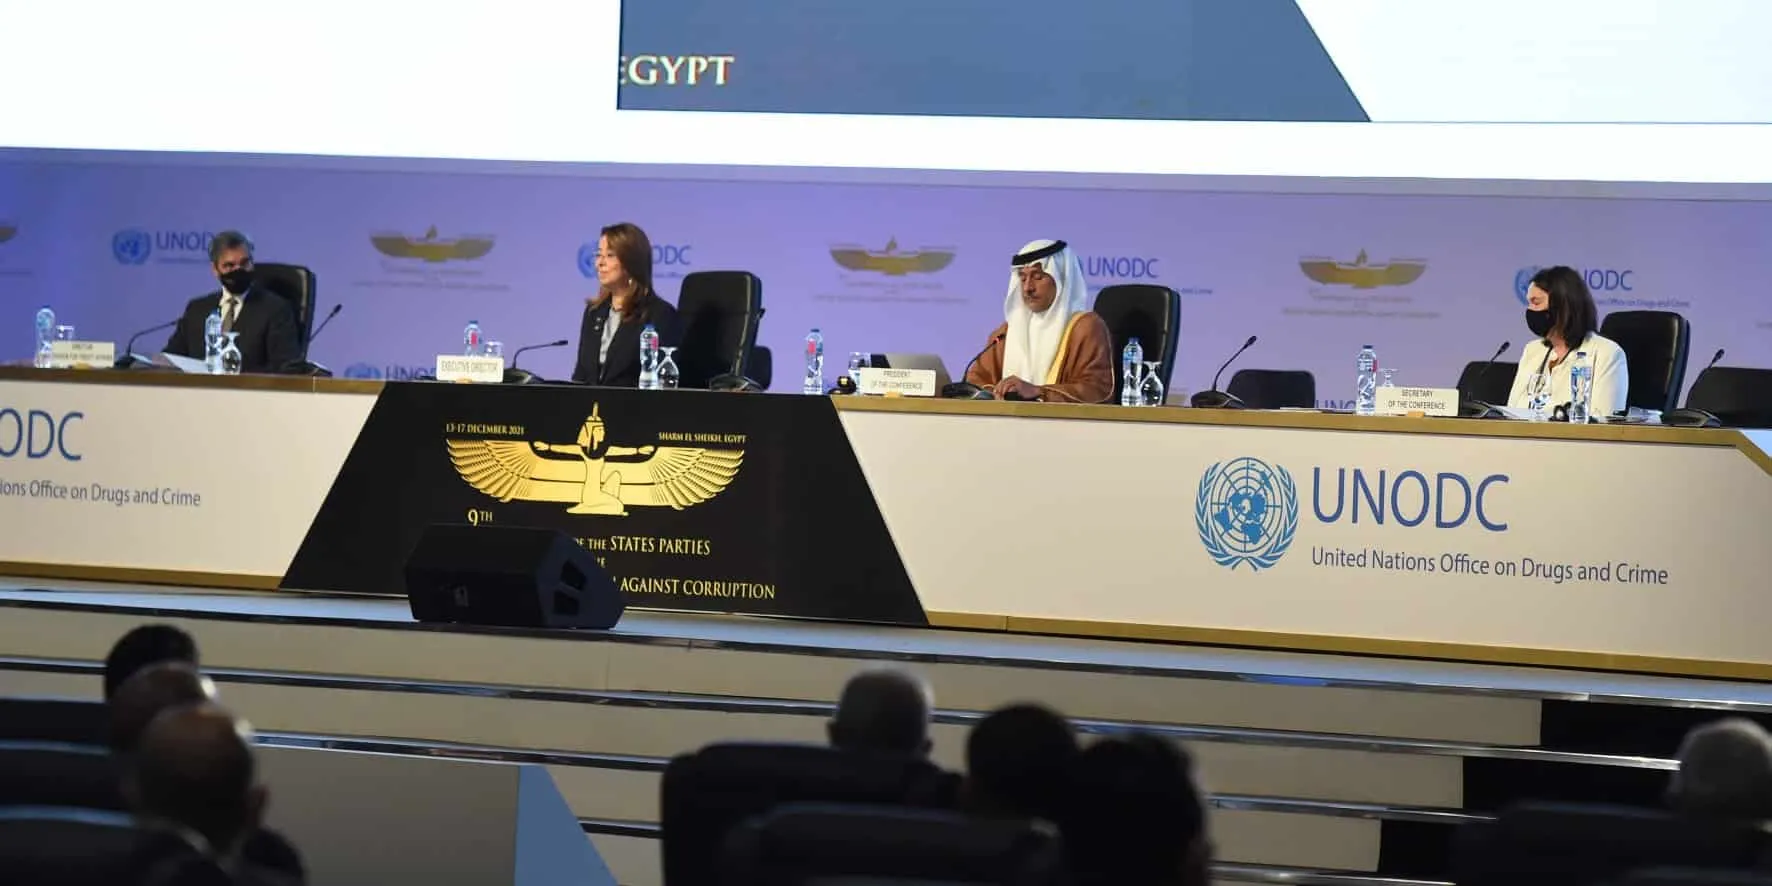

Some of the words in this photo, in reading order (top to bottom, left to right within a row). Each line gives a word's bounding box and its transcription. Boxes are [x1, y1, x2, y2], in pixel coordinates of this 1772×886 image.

[620, 55, 735, 86] GYPT
[156, 231, 216, 251] UNOD
[652, 244, 691, 265] ODC
[1088, 255, 1159, 279] UNODC
[1584, 269, 1633, 291] ODC
[1402, 389, 1433, 397] SECRETARY
[1388, 400, 1396, 408] OF
[1397, 400, 1408, 408] THE
[1409, 401, 1445, 410] CONFERENCE
[446, 423, 466, 433] 13-17
[467, 423, 507, 434] DECEMBER
[658, 431, 683, 441] SHARM
[684, 432, 692, 442] EL
[723, 433, 747, 445] EGYPT
[29, 479, 68, 499] Office
[70, 486, 88, 500] on
[91, 482, 130, 507] Drugs
[132, 488, 159, 505] and
[161, 488, 201, 507] Crime
[1311, 467, 1510, 532] UNODC
[468, 508, 493, 527] 9TH
[587, 537, 607, 550] THE
[610, 535, 655, 553] STATES
[659, 538, 711, 556] PARTIES
[1312, 545, 1367, 568] United
[1372, 549, 1436, 572] Nations
[1440, 552, 1490, 575] Office
[1494, 560, 1516, 577] on
[1522, 557, 1573, 584] Drugs
[1577, 561, 1610, 582] and
[1616, 562, 1668, 585] Crime
[620, 576, 680, 595] AGAINST
[683, 579, 776, 600] CORRUPTION
